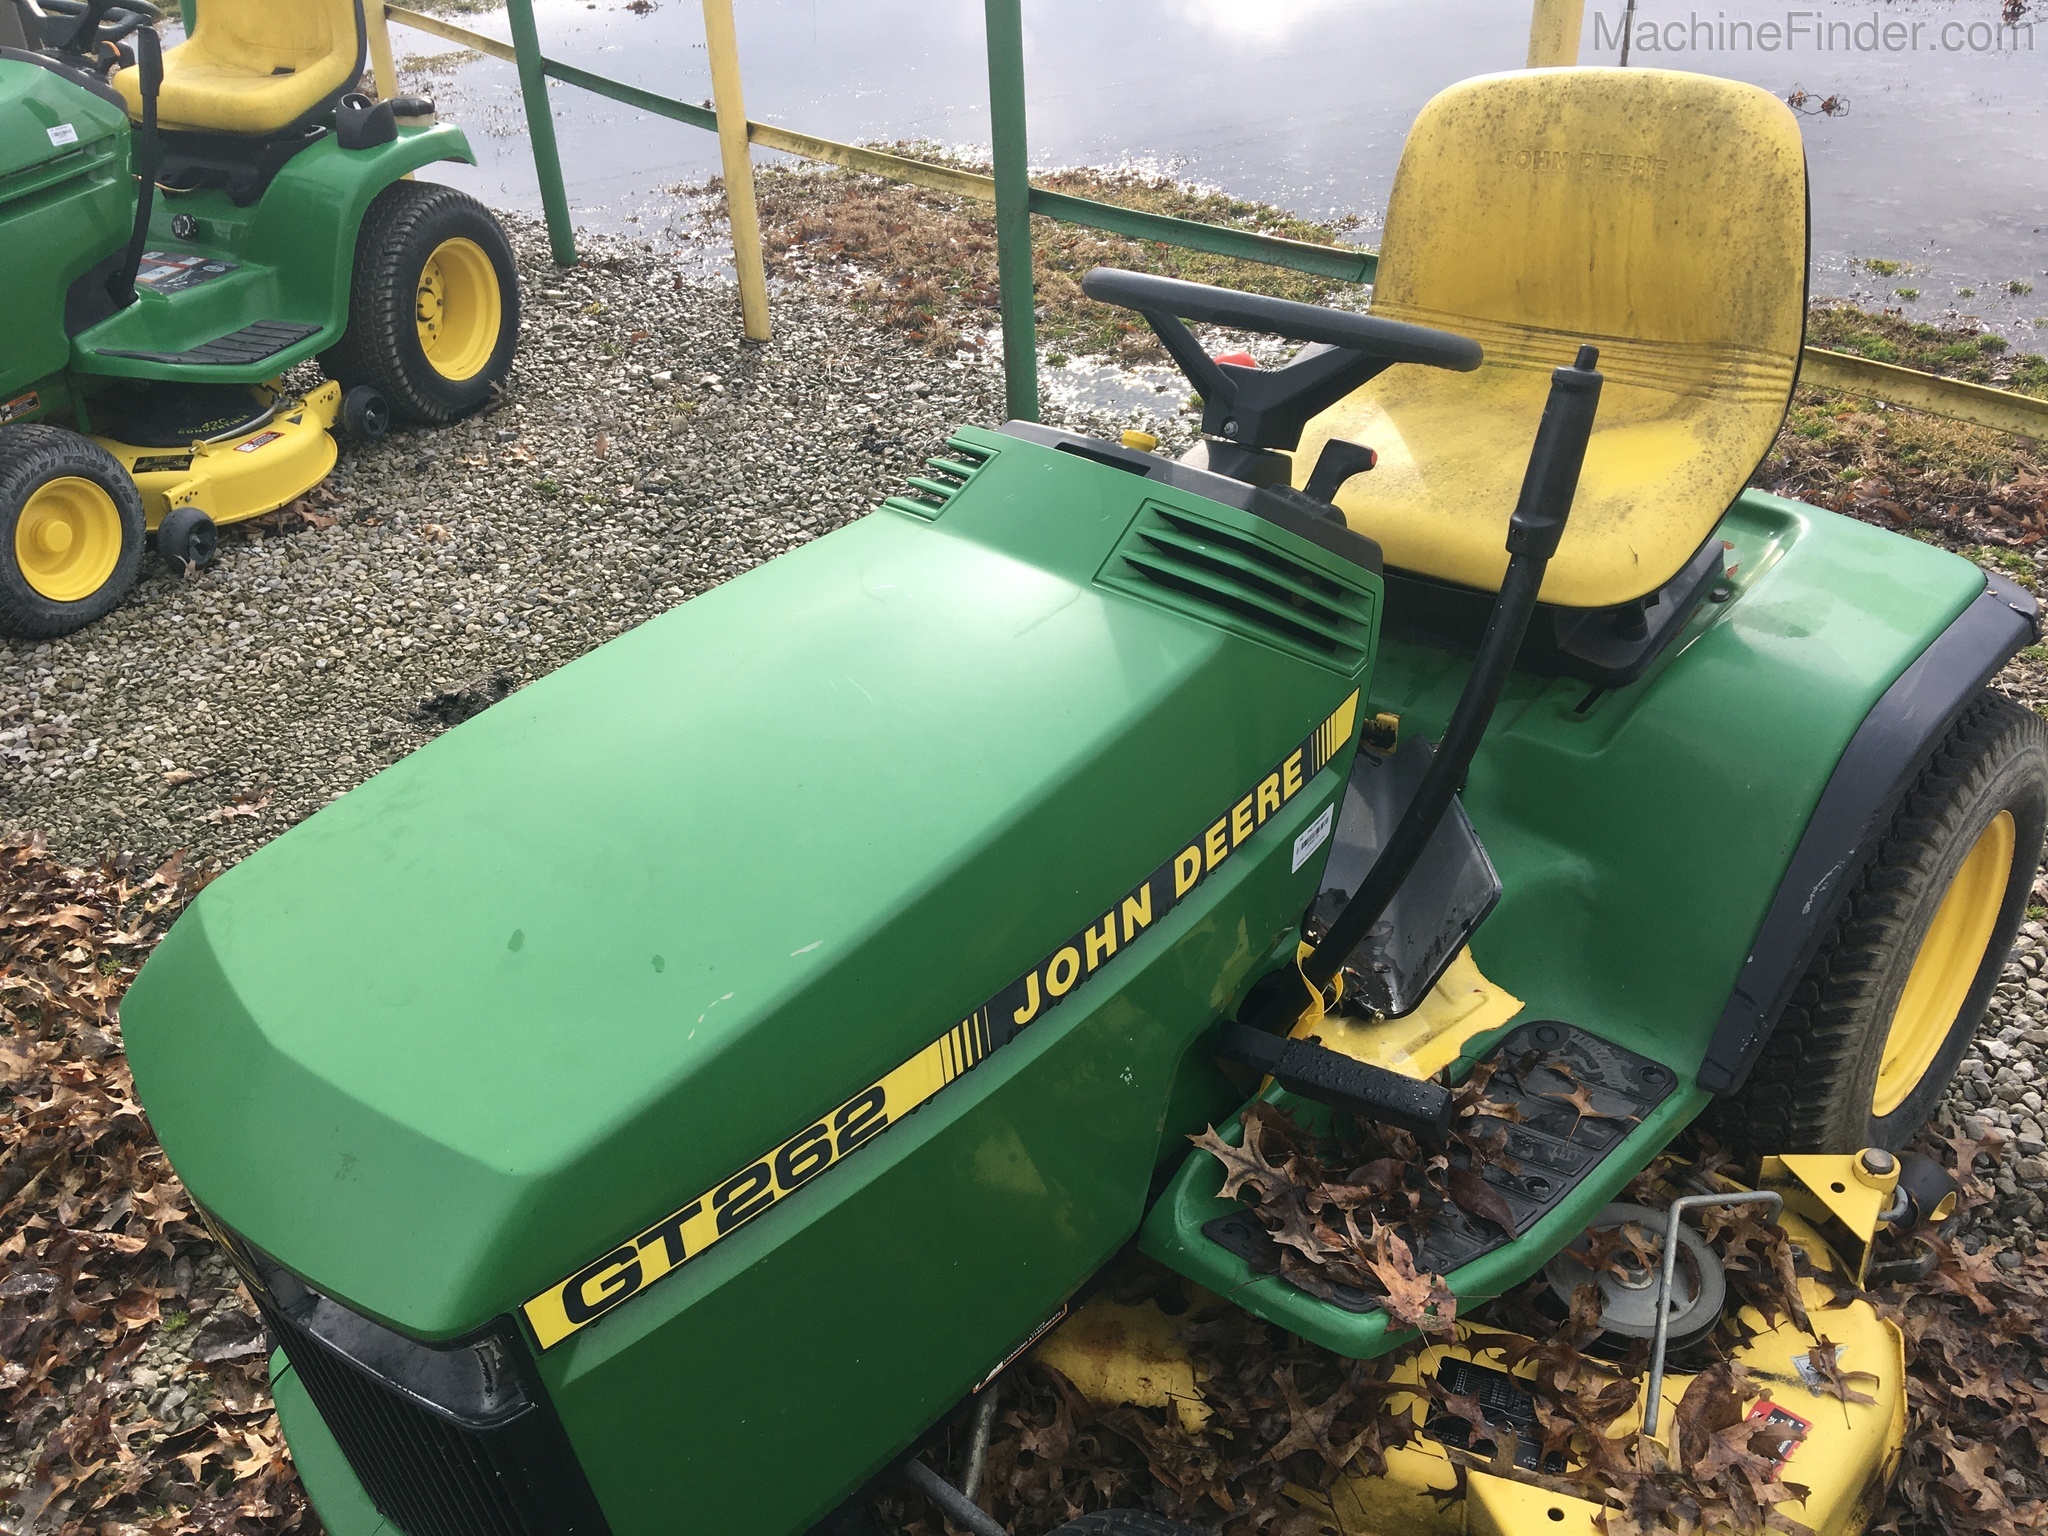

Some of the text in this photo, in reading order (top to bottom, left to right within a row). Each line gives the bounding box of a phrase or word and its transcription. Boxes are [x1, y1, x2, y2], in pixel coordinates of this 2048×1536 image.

[1499, 150, 1669, 181] JOHN DEERE
[1013, 747, 1303, 1025] JOHN DEERE
[561, 1085, 889, 1325] GT262
